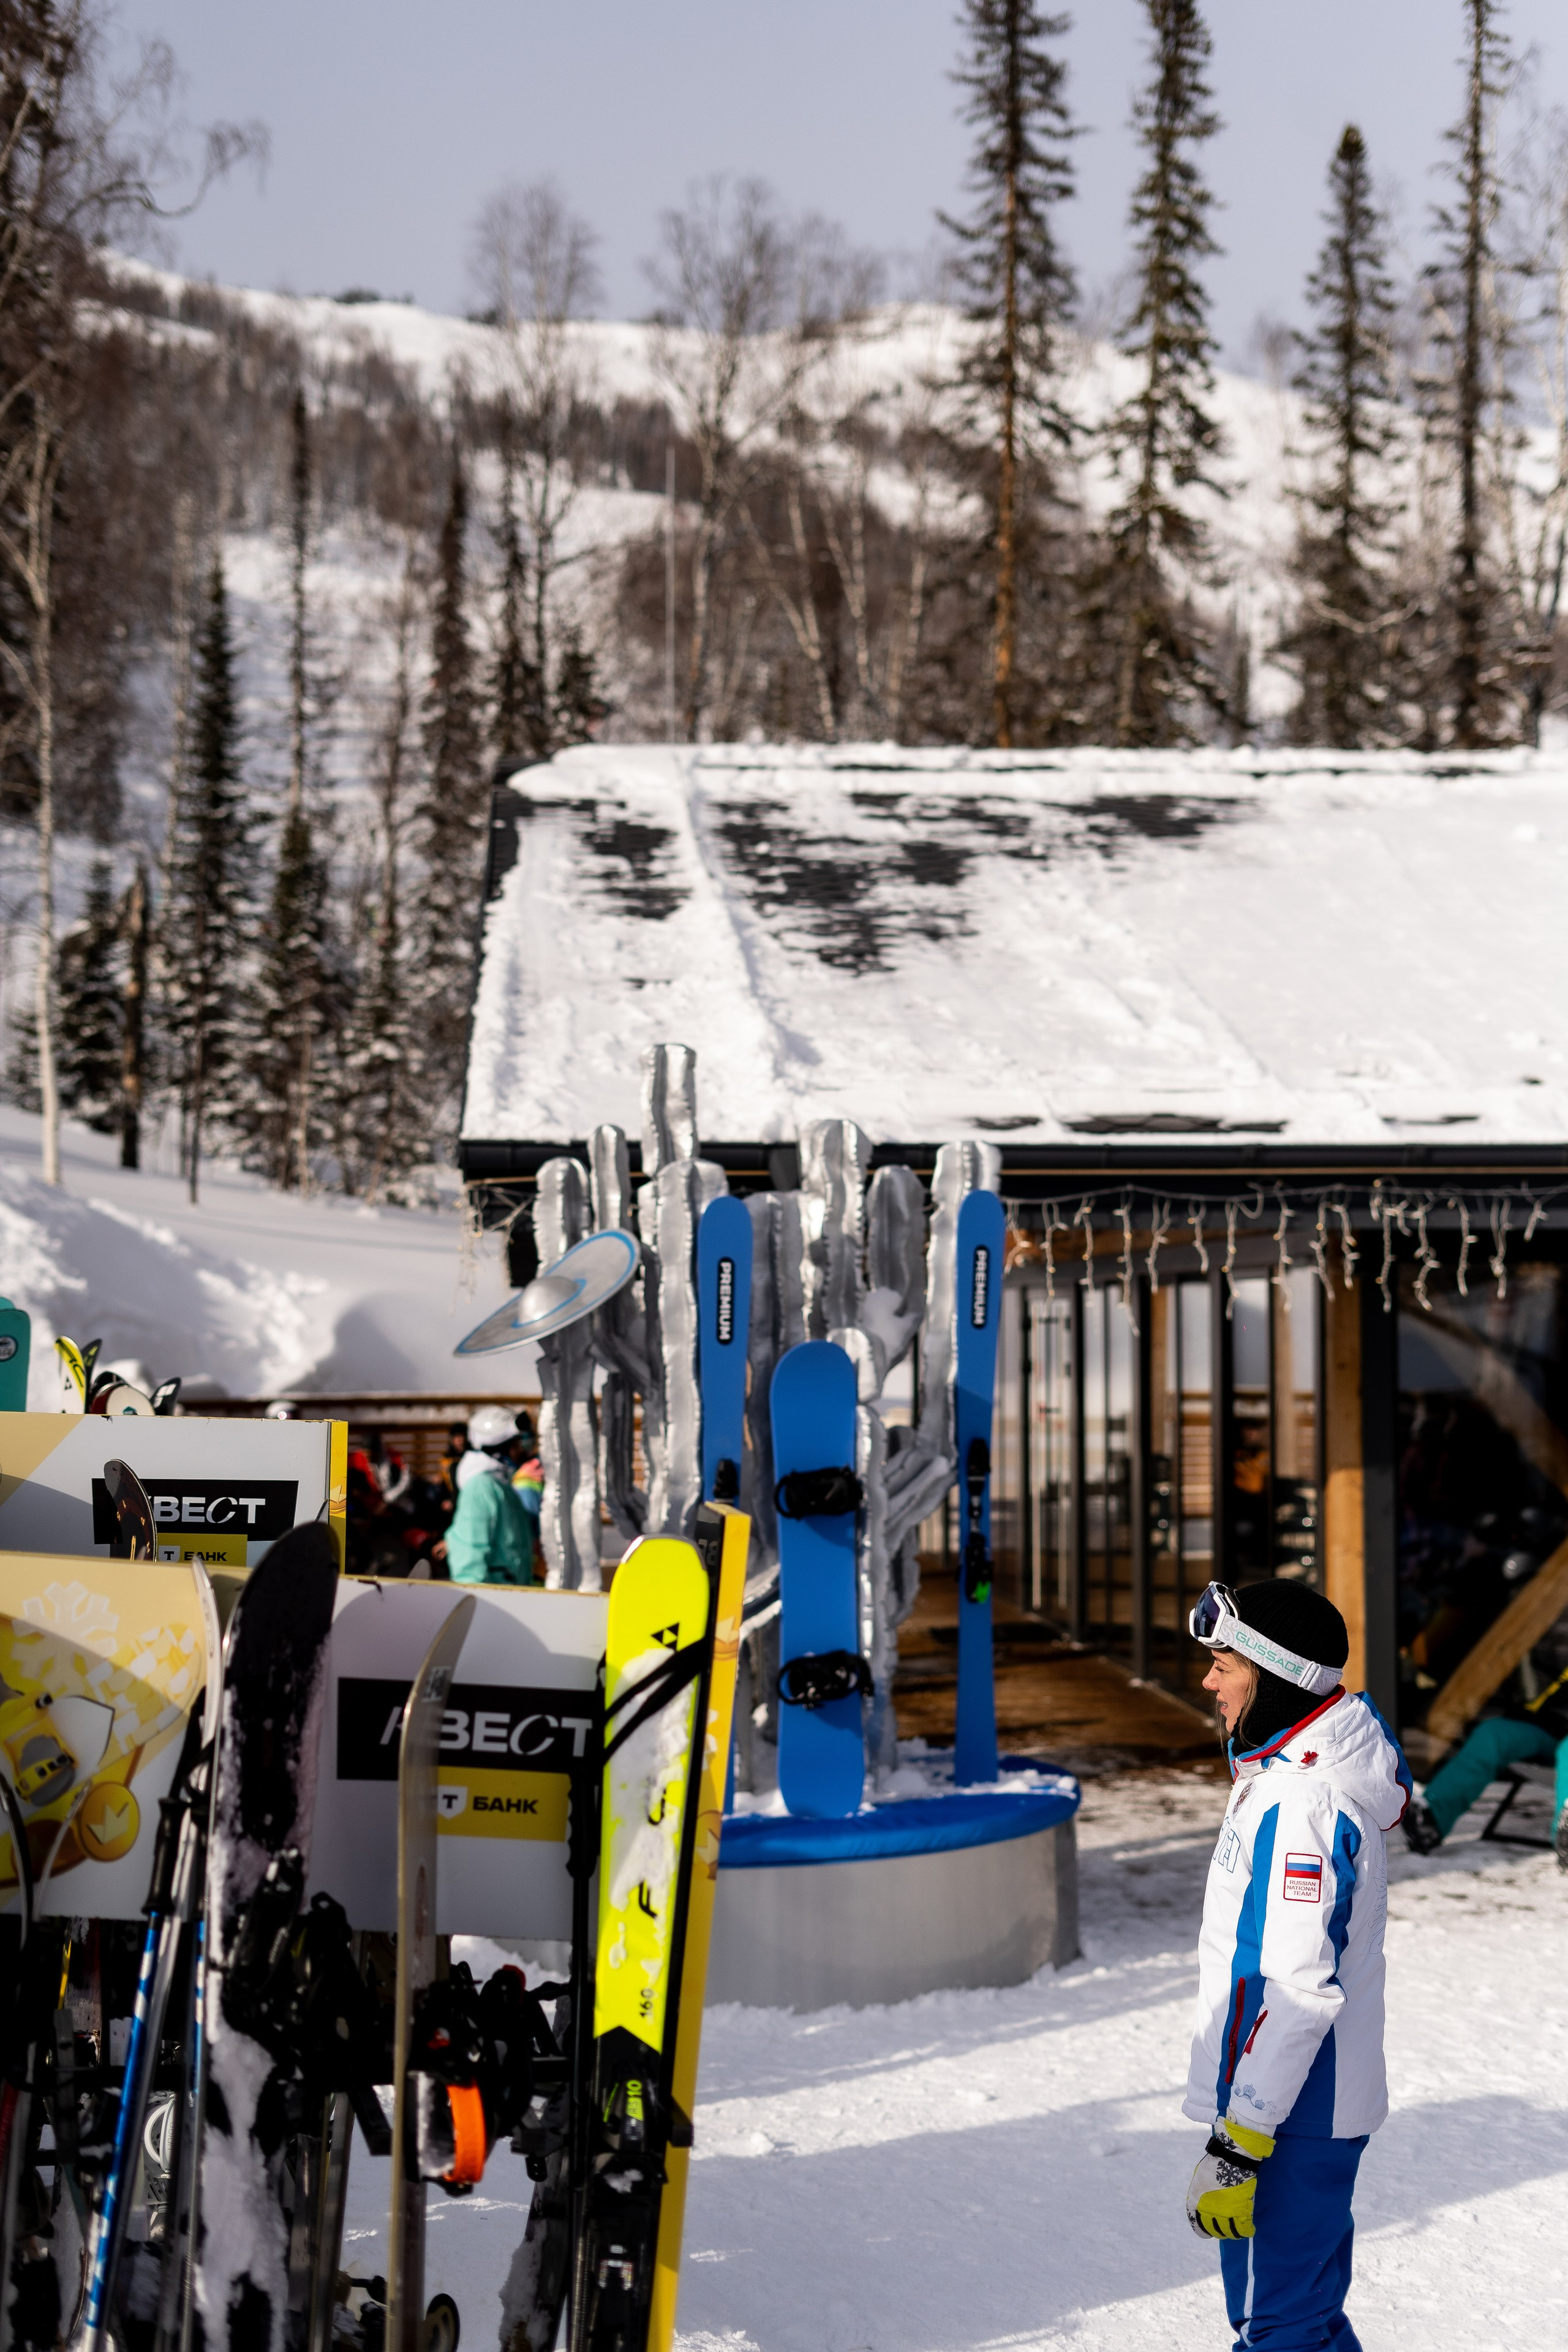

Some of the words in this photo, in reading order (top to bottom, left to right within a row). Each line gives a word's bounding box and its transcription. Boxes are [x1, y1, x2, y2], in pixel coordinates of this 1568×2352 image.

[719, 1262, 732, 1340] PREMIUM
[973, 1249, 987, 1325] PREMIUM
[148, 1496, 266, 1524] ВЕСТ
[1235, 1630, 1305, 1676] GLISSADE
[472, 1795, 538, 1815] БАНК
